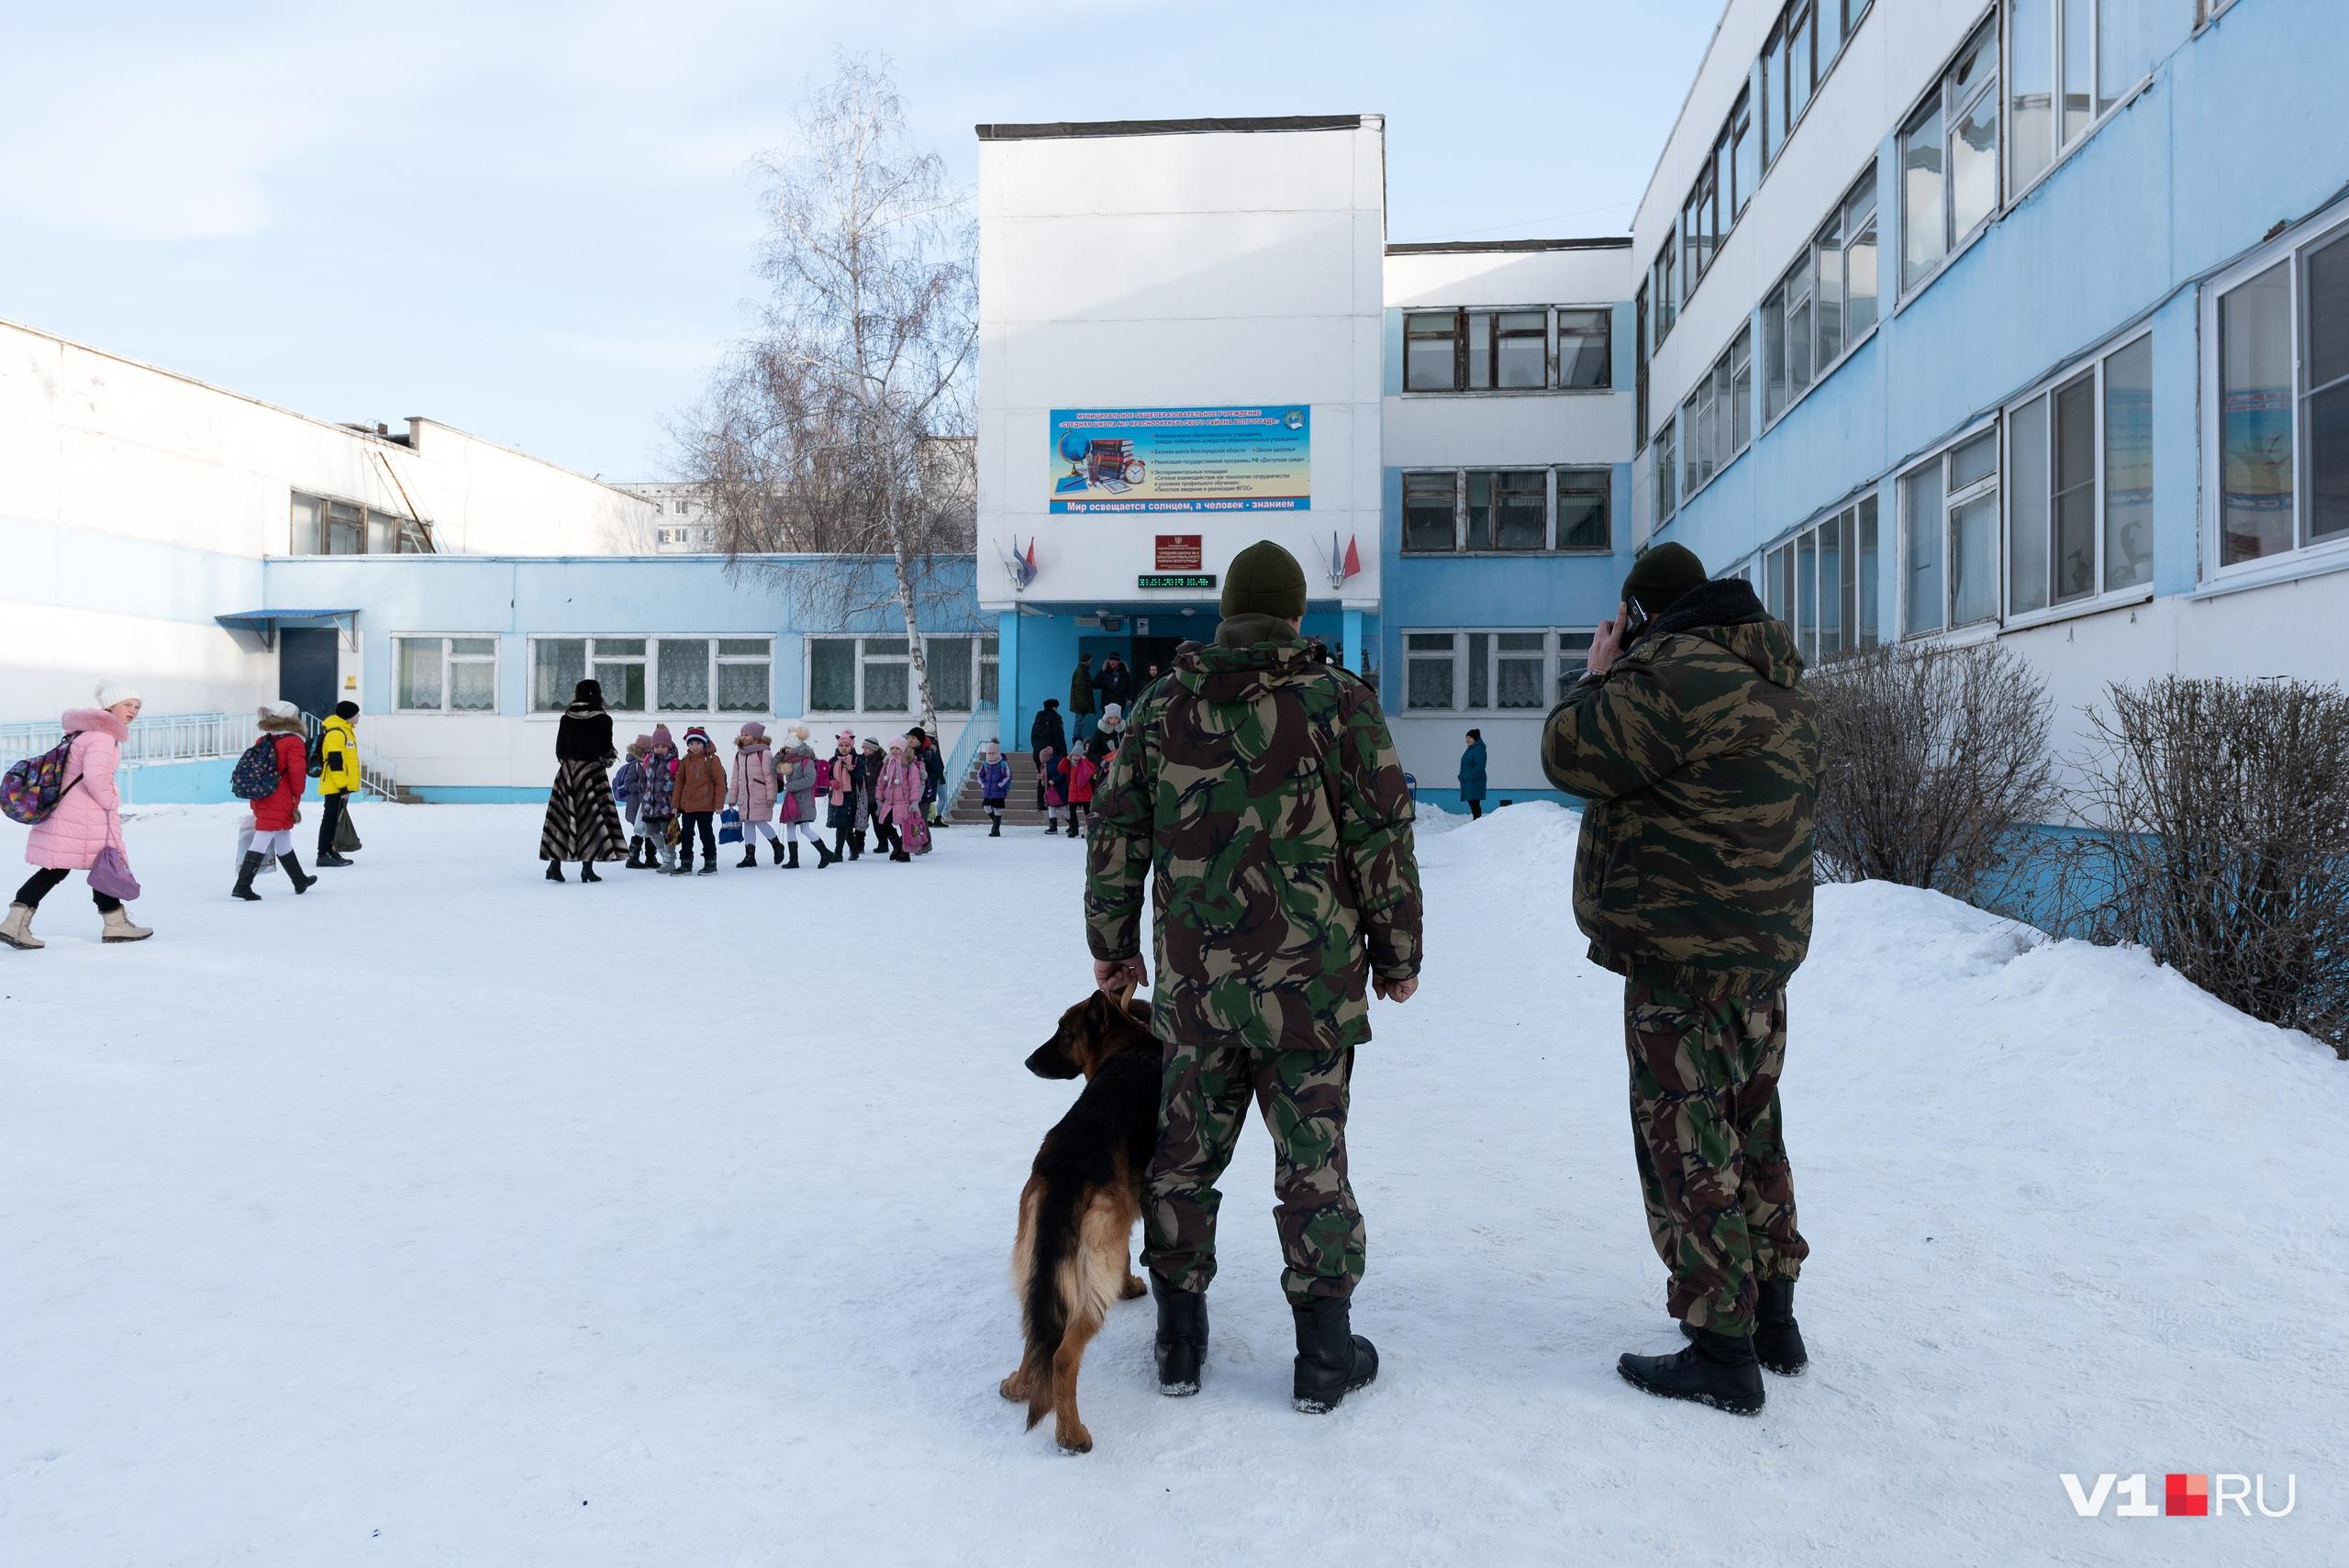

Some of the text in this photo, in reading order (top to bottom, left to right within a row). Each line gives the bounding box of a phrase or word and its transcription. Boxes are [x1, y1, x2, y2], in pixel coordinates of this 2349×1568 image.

[1130, 419, 1205, 428] КРАСНООКТЯБРЬСКОГО
[1067, 502, 1087, 512] Мир
[1089, 503, 1145, 512] освещается
[1148, 502, 1193, 511] солнцем,
